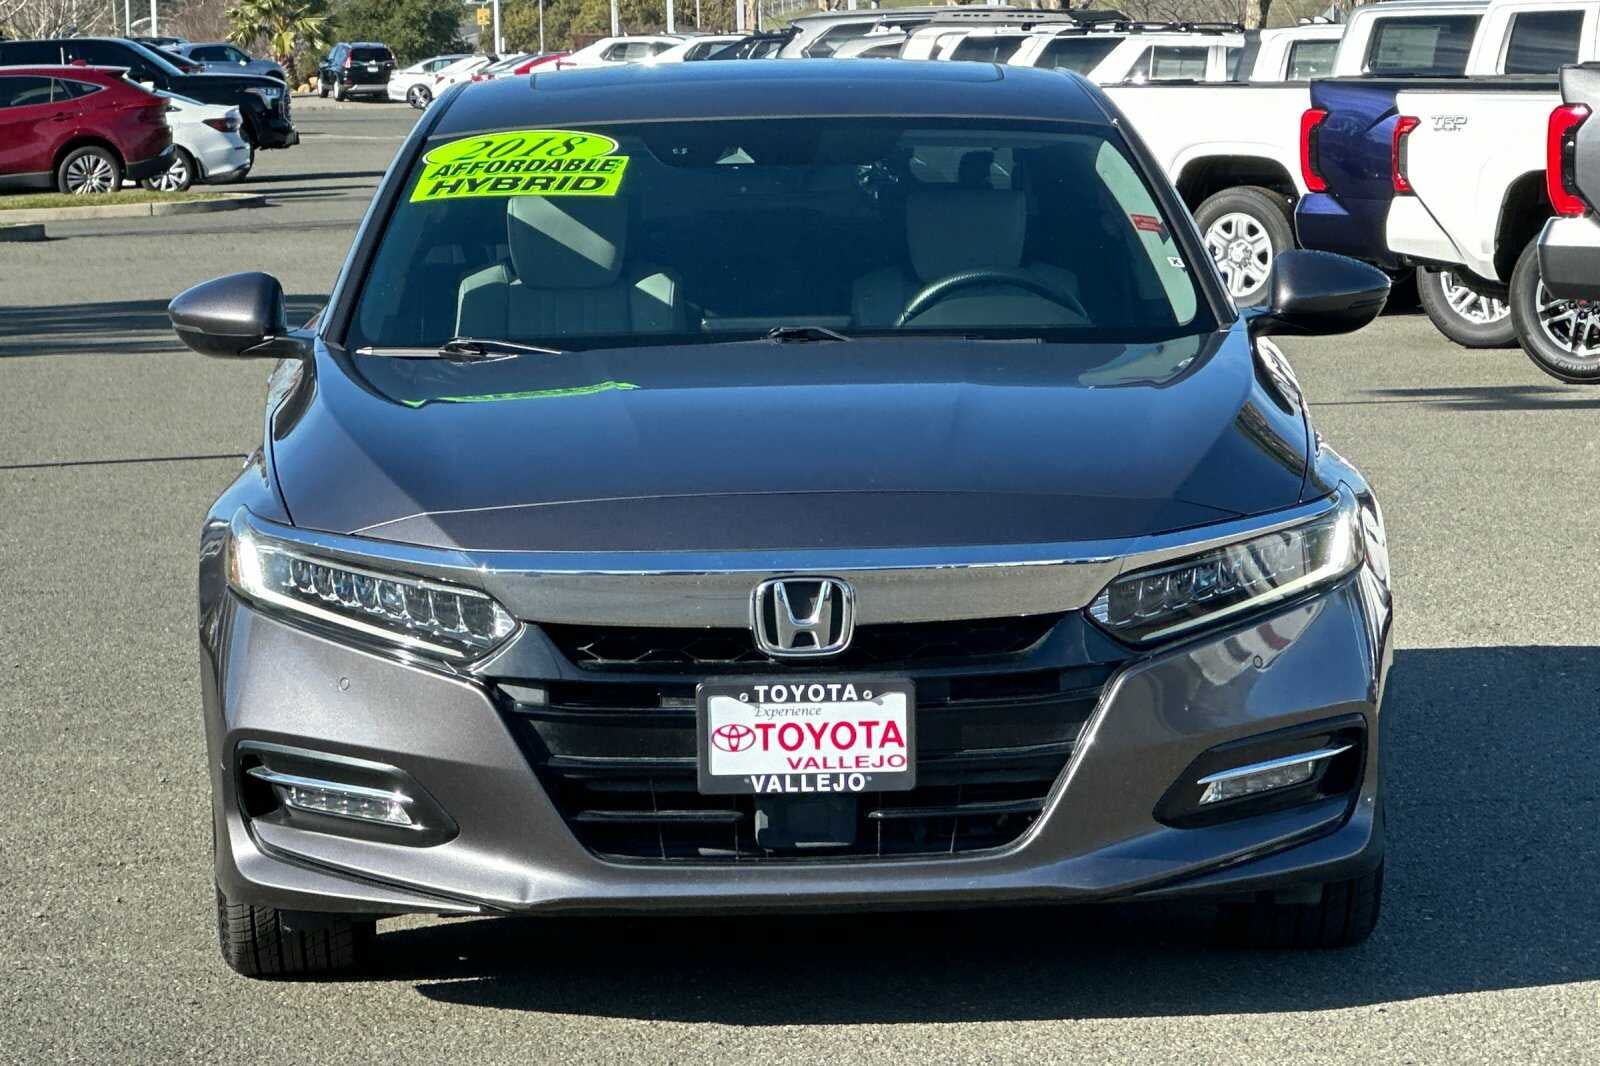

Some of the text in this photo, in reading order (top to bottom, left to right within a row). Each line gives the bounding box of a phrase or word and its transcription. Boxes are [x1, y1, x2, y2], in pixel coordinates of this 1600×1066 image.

[451, 136, 588, 161] 2018
[428, 157, 623, 179] AFFORDABLE
[427, 175, 607, 196] HYBRID
[754, 683, 858, 703] TOYOTA
[754, 705, 822, 720] Experience
[755, 720, 905, 751] TOYOTA
[786, 754, 907, 770] VALLEJO
[750, 773, 867, 793] VALLEJO
